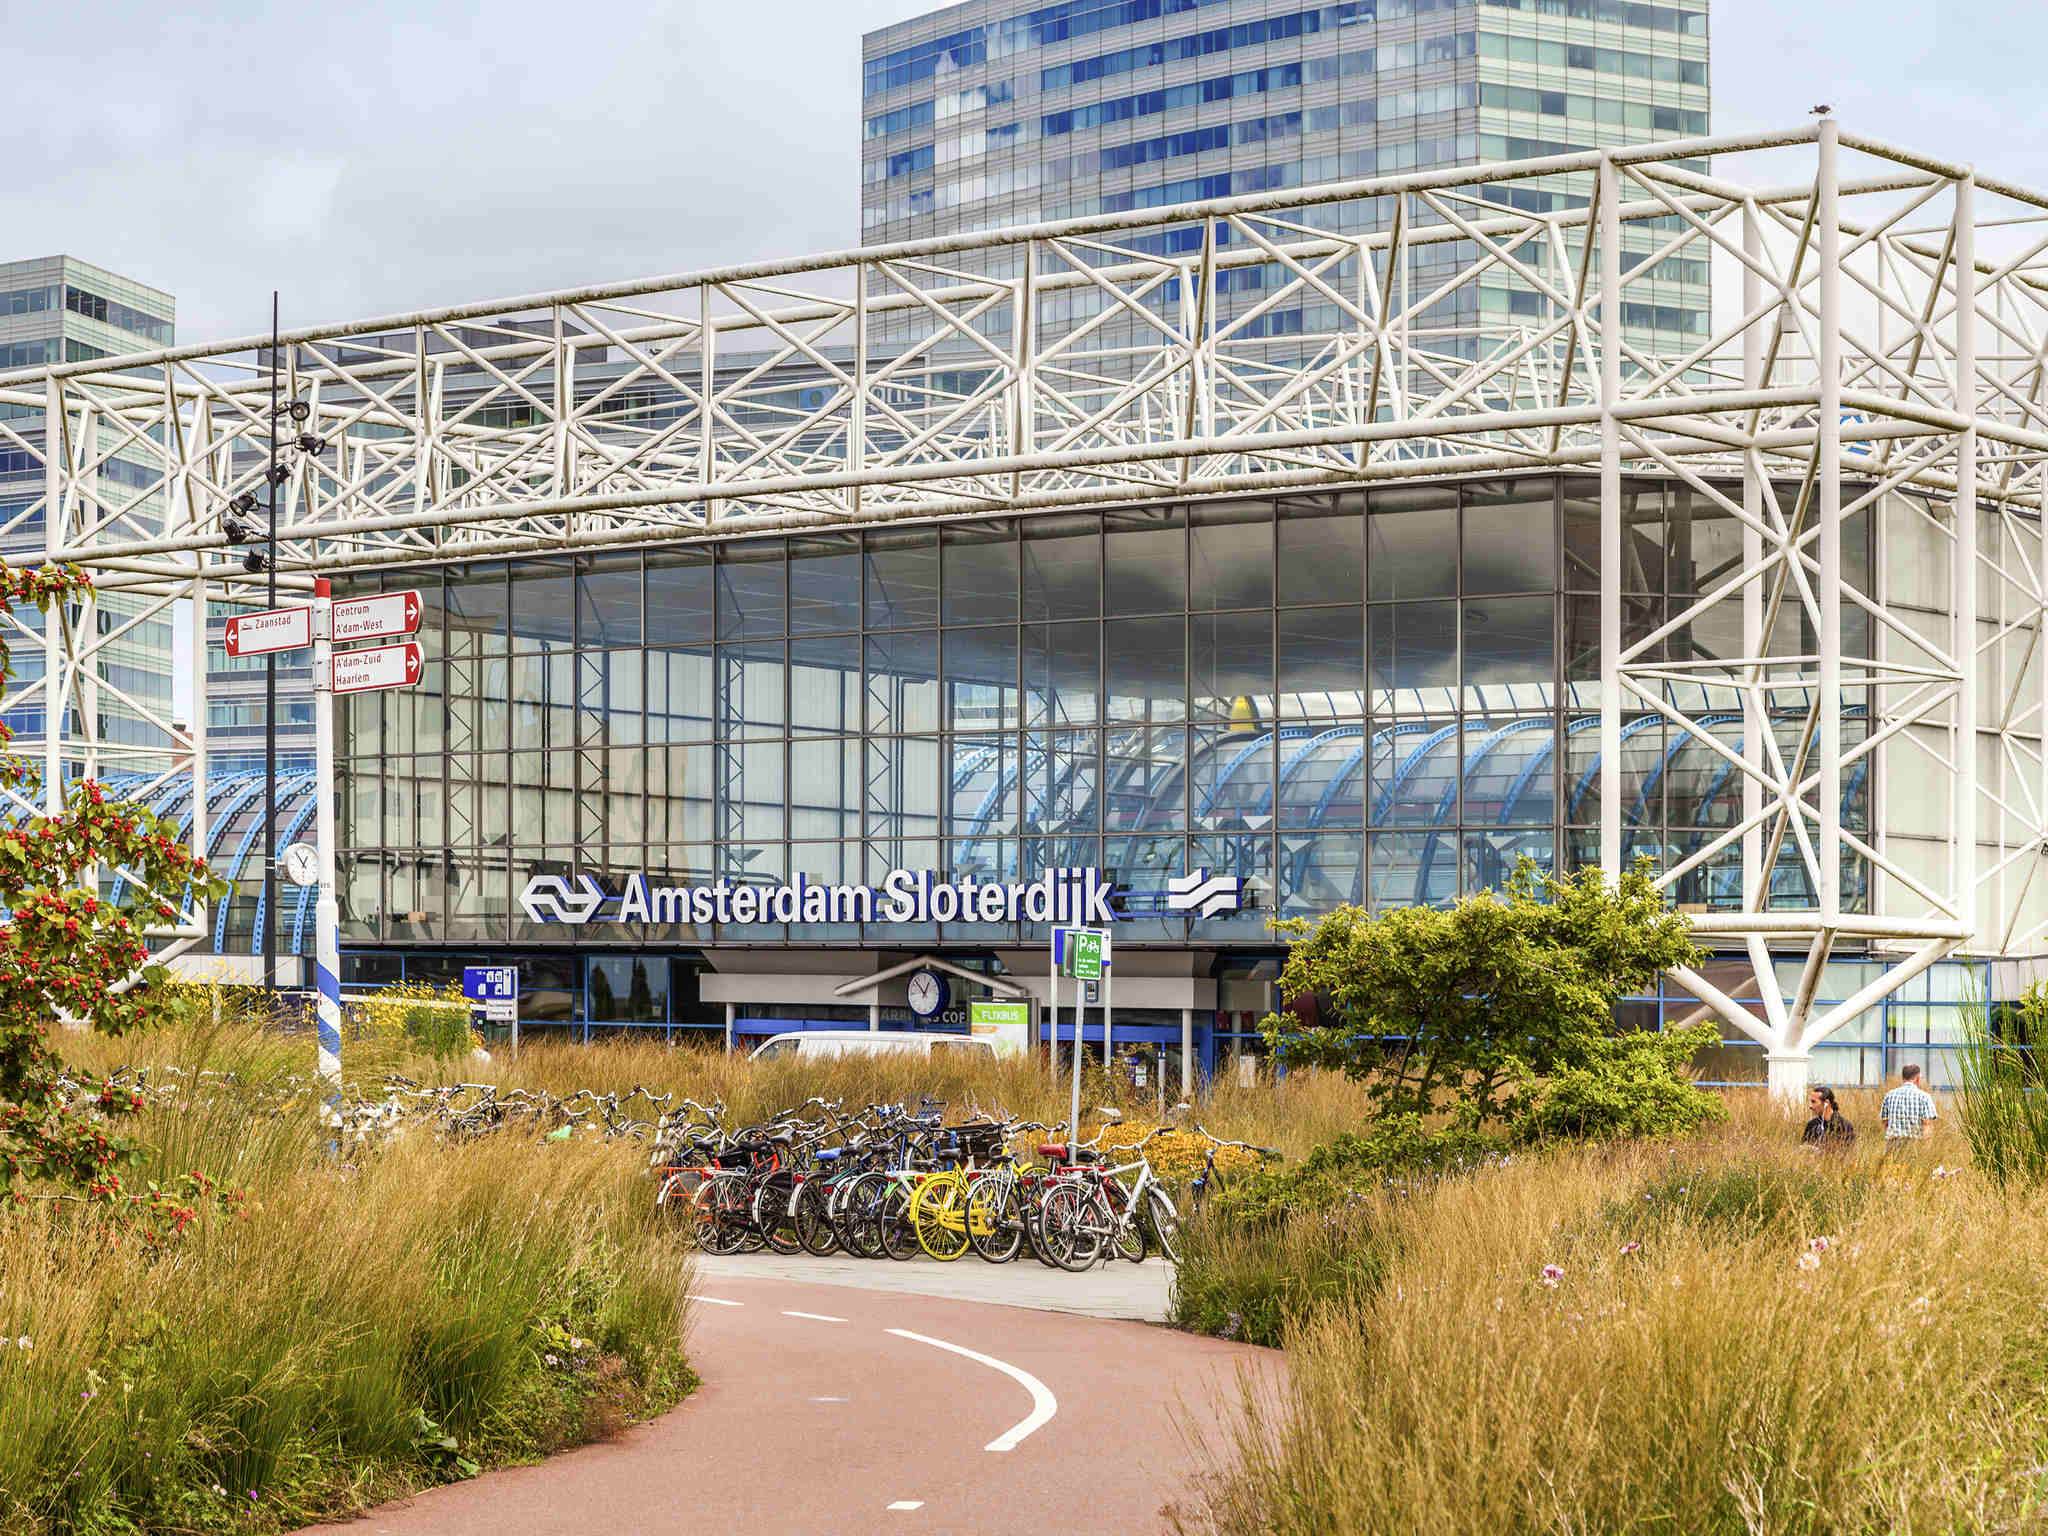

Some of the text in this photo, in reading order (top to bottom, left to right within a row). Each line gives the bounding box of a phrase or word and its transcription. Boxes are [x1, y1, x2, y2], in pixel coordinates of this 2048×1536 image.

[335, 604, 369, 617] Centrum
[255, 615, 291, 629] Zaanstad
[335, 619, 383, 634] A'dam-West
[336, 653, 381, 668] A'dam-Zuid
[336, 672, 370, 686] Haarlem
[618, 866, 1113, 926] Amsterdam Sloterdijk
